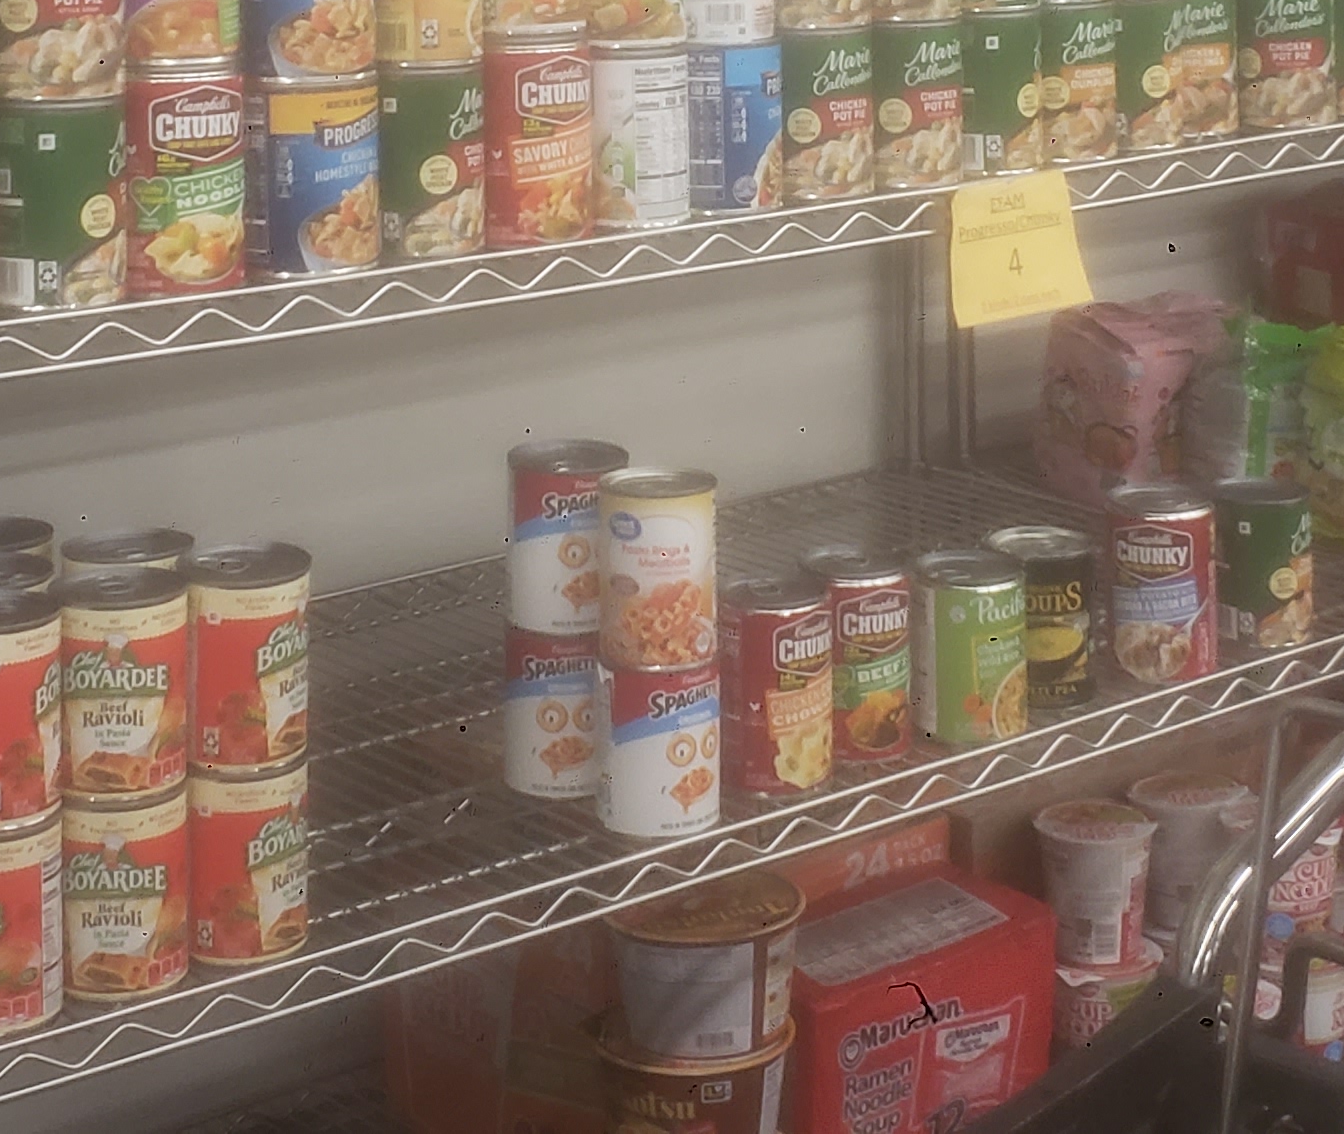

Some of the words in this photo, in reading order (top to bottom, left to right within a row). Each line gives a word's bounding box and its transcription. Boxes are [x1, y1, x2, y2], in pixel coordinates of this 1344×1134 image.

[522, 77, 590, 106] CHUNKY
[156, 111, 240, 141] CHUNKY
[513, 141, 567, 164] SAVORY
[1009, 247, 1023, 275] 4
[1116, 540, 1188, 566] CHUNKY
[1026, 581, 1081, 613] OUPS
[843, 607, 907, 636] CHUNKY
[65, 665, 168, 692] BOYARDEE
[83, 710, 143, 728] Ravioli
[64, 866, 166, 892] BOYARDEE
[82, 910, 142, 929] Ravioli
[98, 903, 124, 913] Beef
[845, 1057, 913, 1095] Ramen
[844, 1079, 913, 1119] Noodle
